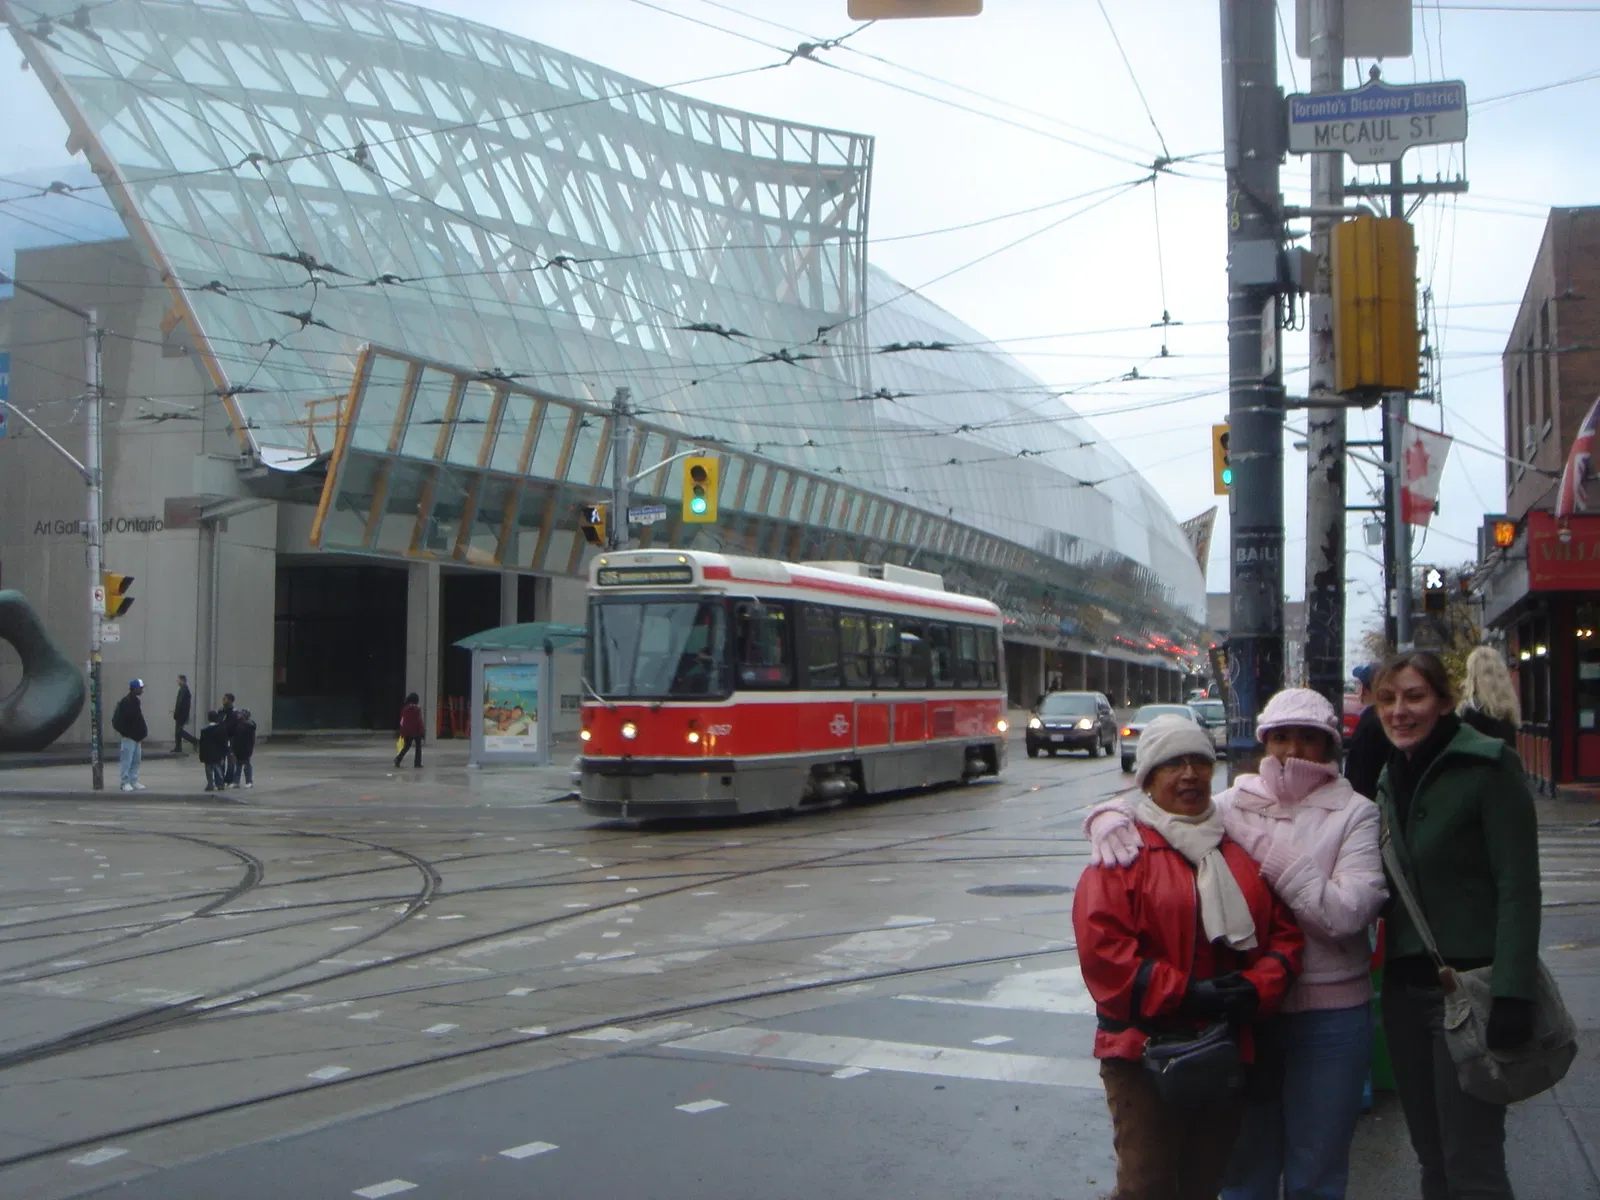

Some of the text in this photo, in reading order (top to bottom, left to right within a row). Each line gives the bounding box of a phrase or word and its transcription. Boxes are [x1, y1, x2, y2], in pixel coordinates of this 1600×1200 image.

[1294, 88, 1461, 118] Toronto's Discovery District
[34, 520, 51, 535] Art
[117, 517, 164, 533] Ontario
